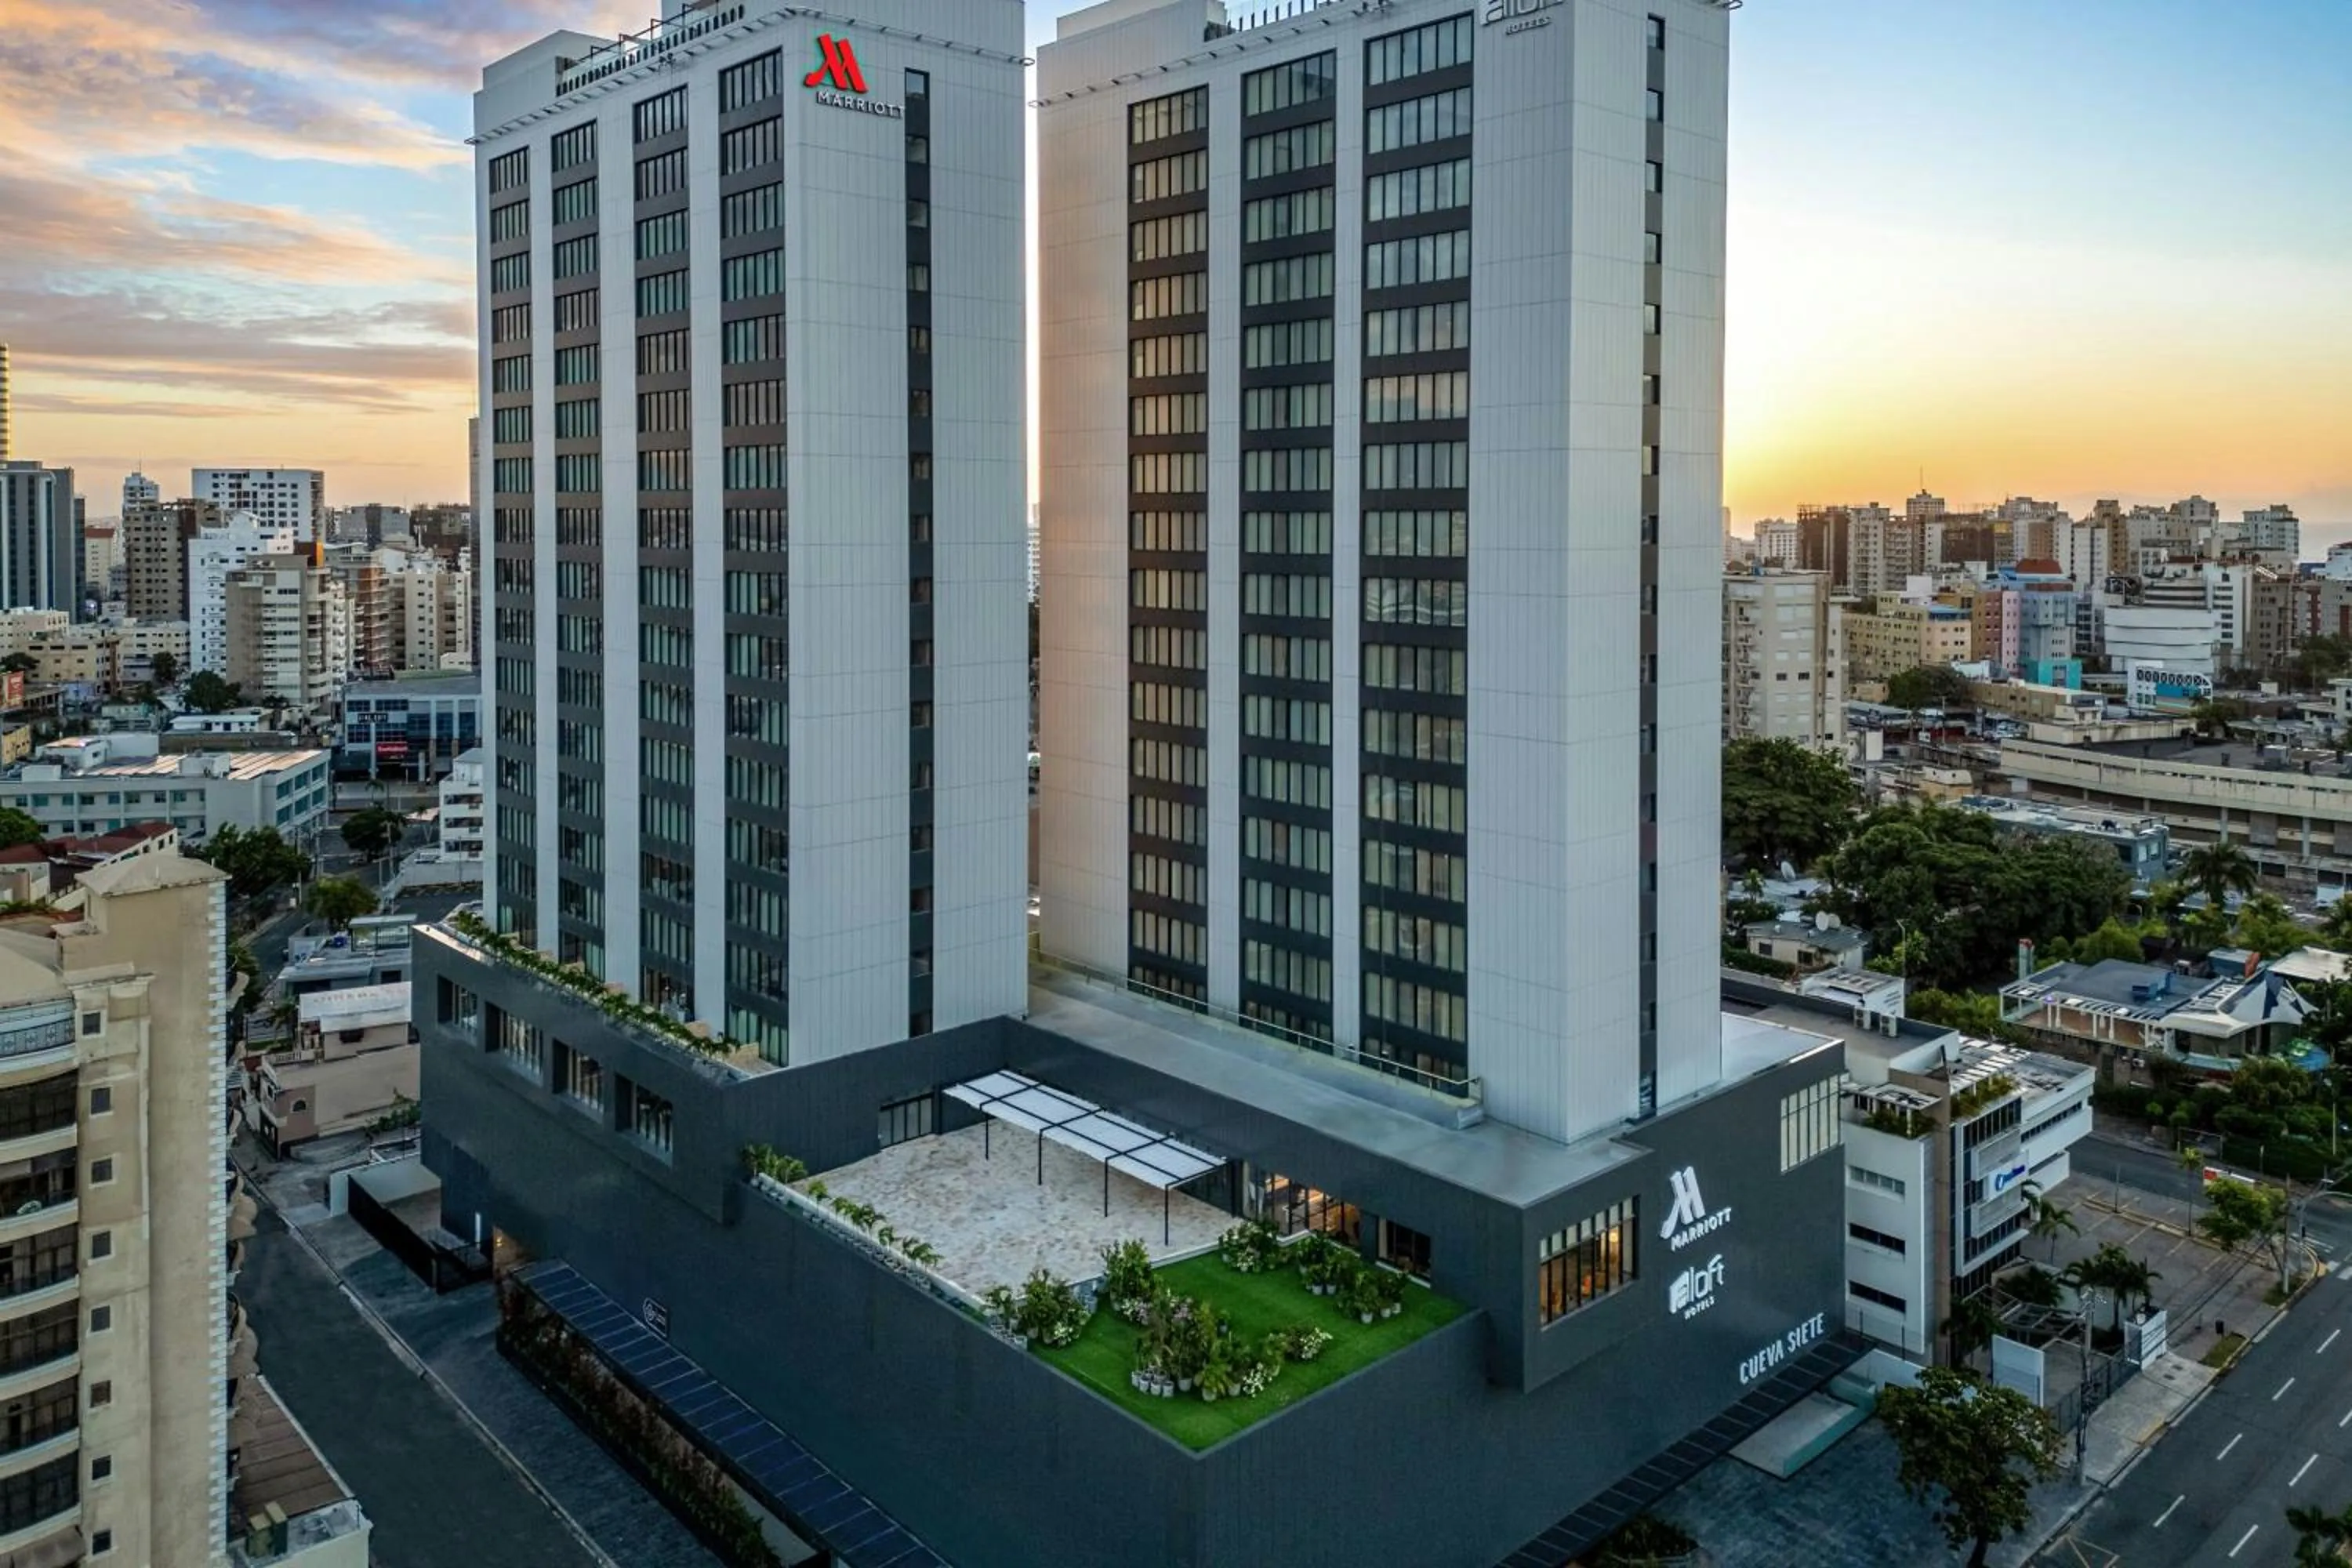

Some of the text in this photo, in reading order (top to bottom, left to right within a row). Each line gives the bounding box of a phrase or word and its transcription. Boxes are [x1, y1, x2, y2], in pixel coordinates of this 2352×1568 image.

[817, 91, 906, 118] MARRIOTT
[1671, 1207, 1731, 1251] MARRIOTT
[1670, 1254, 1724, 1313] aloft
[1740, 1312, 1824, 1385] CUEVA SIETE
